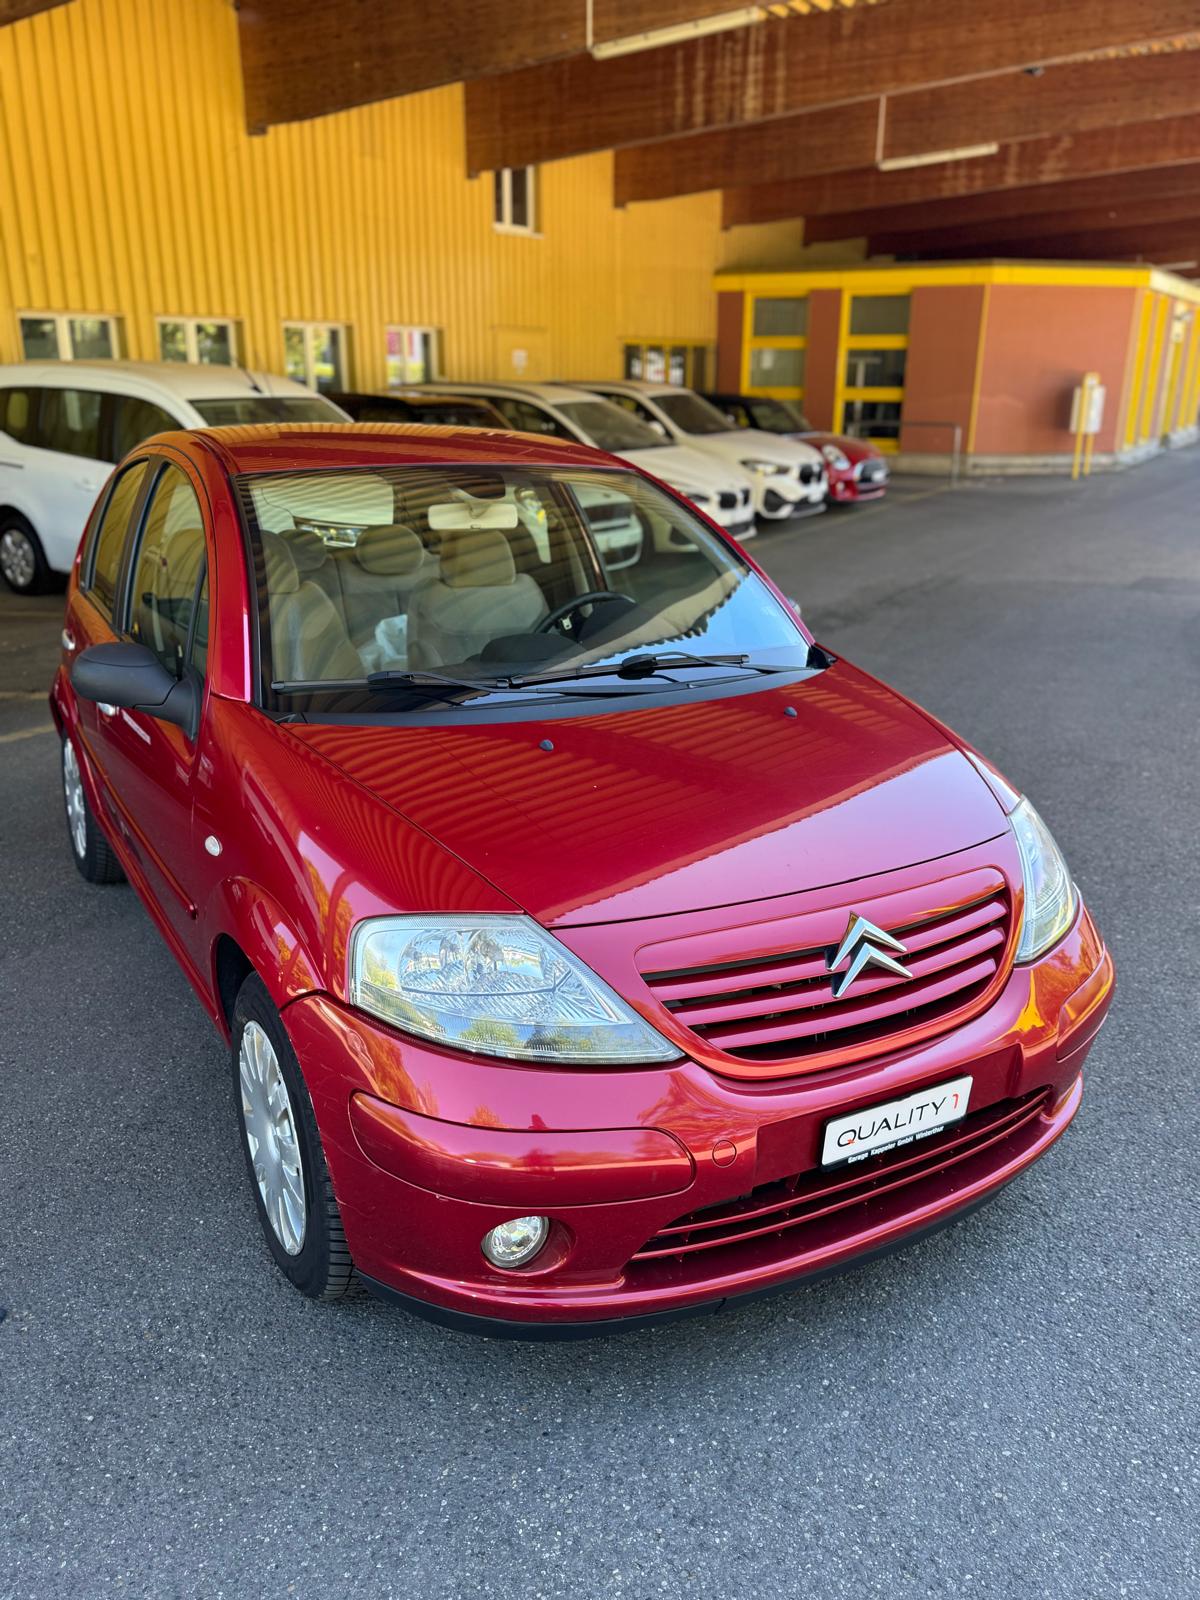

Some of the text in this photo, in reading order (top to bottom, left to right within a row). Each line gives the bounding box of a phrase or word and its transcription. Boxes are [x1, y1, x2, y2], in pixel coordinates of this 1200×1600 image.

[837, 1093, 959, 1148] QUALITY 1
[847, 1152, 869, 1164] Garage
[897, 1136, 914, 1147] GmbH
